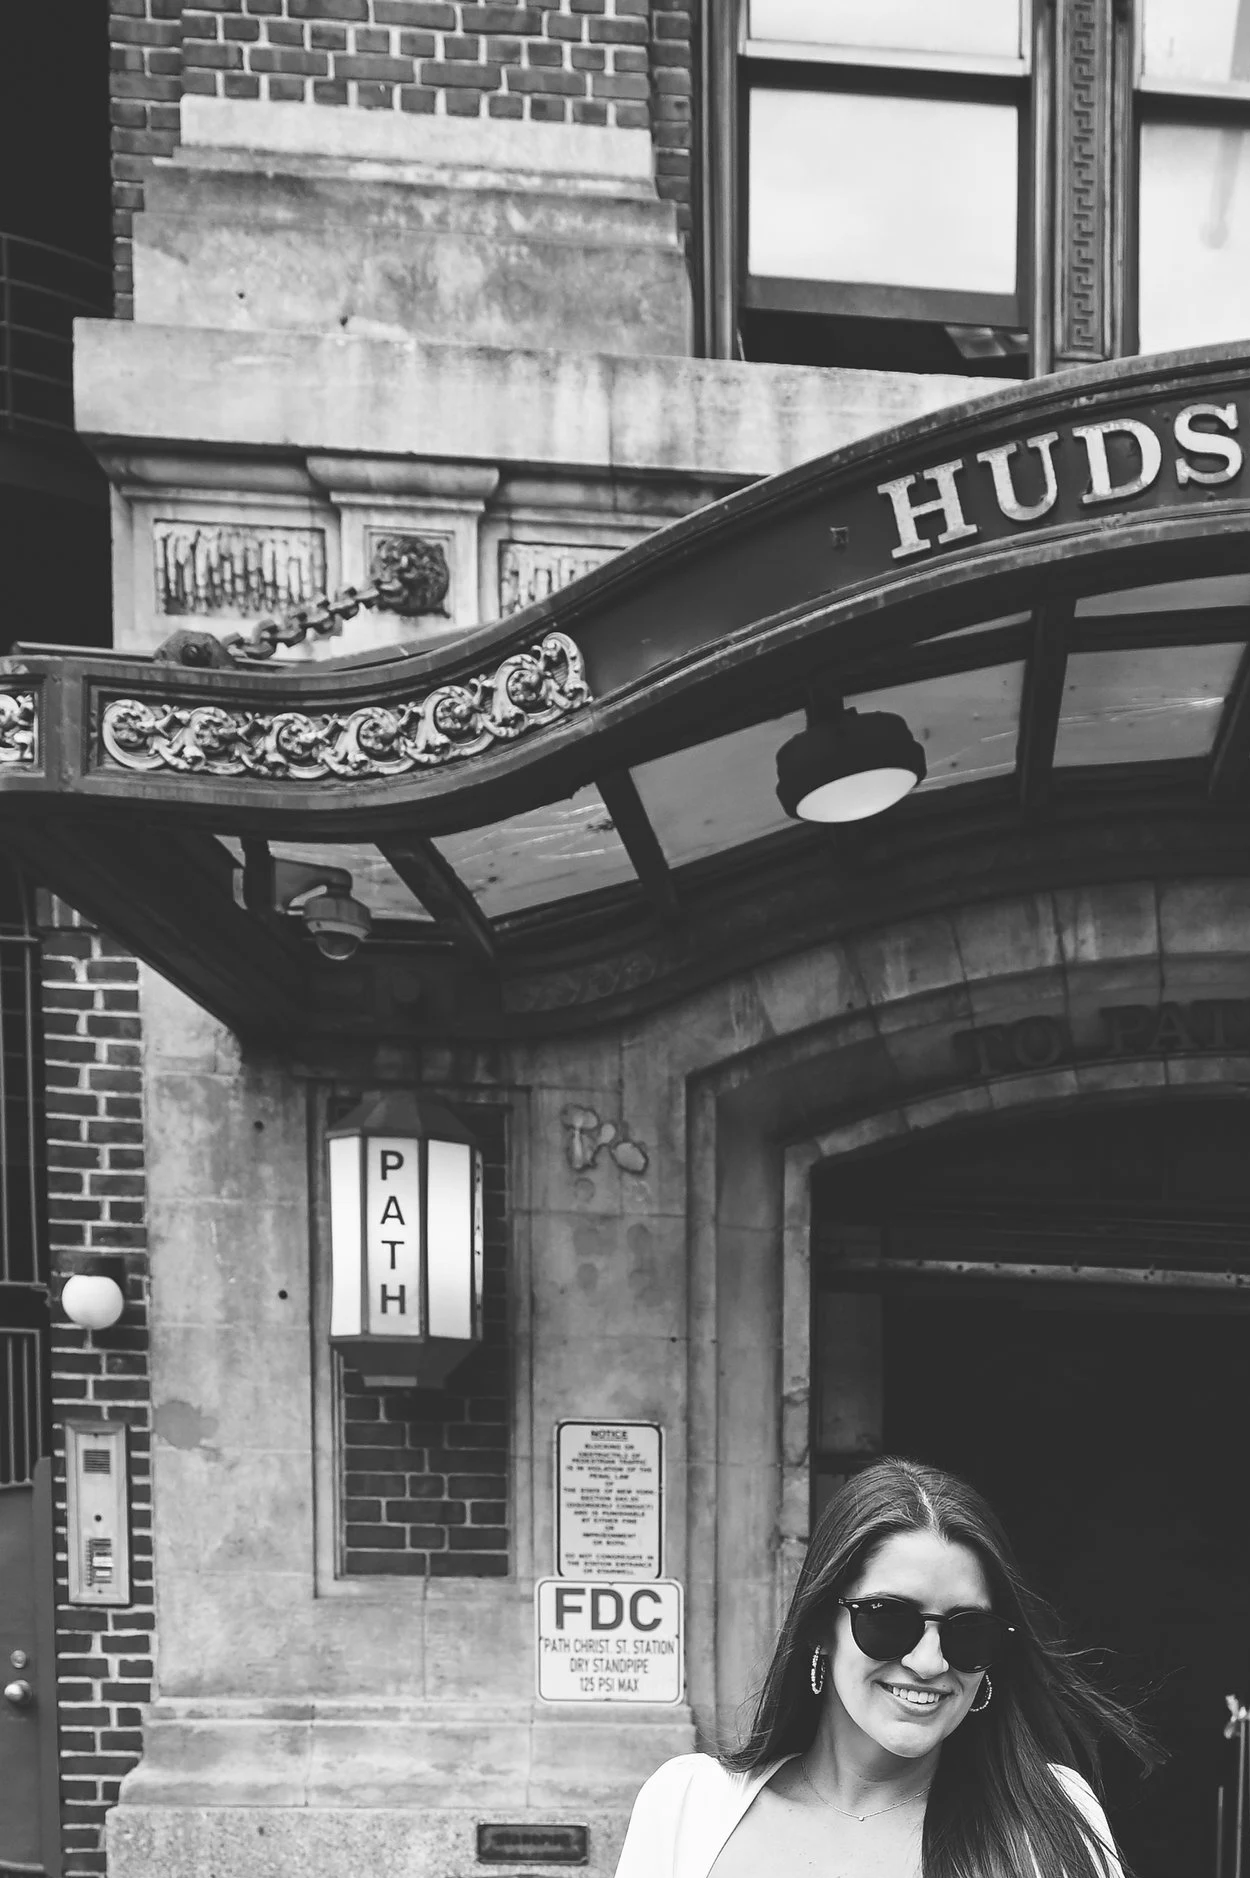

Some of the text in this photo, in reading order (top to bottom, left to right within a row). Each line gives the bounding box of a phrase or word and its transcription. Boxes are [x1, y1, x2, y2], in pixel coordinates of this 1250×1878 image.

[956, 1017, 1063, 1077] TO
[380, 1149, 406, 1315] PATH
[590, 1430, 628, 1440] NOTICE
[555, 1588, 662, 1632] FDC
[544, 1638, 571, 1653] PATH
[633, 1639, 675, 1655] STATION
[570, 1658, 649, 1674] DRY STANDPIPE
[580, 1677, 640, 1693] 125 PSI MAX
